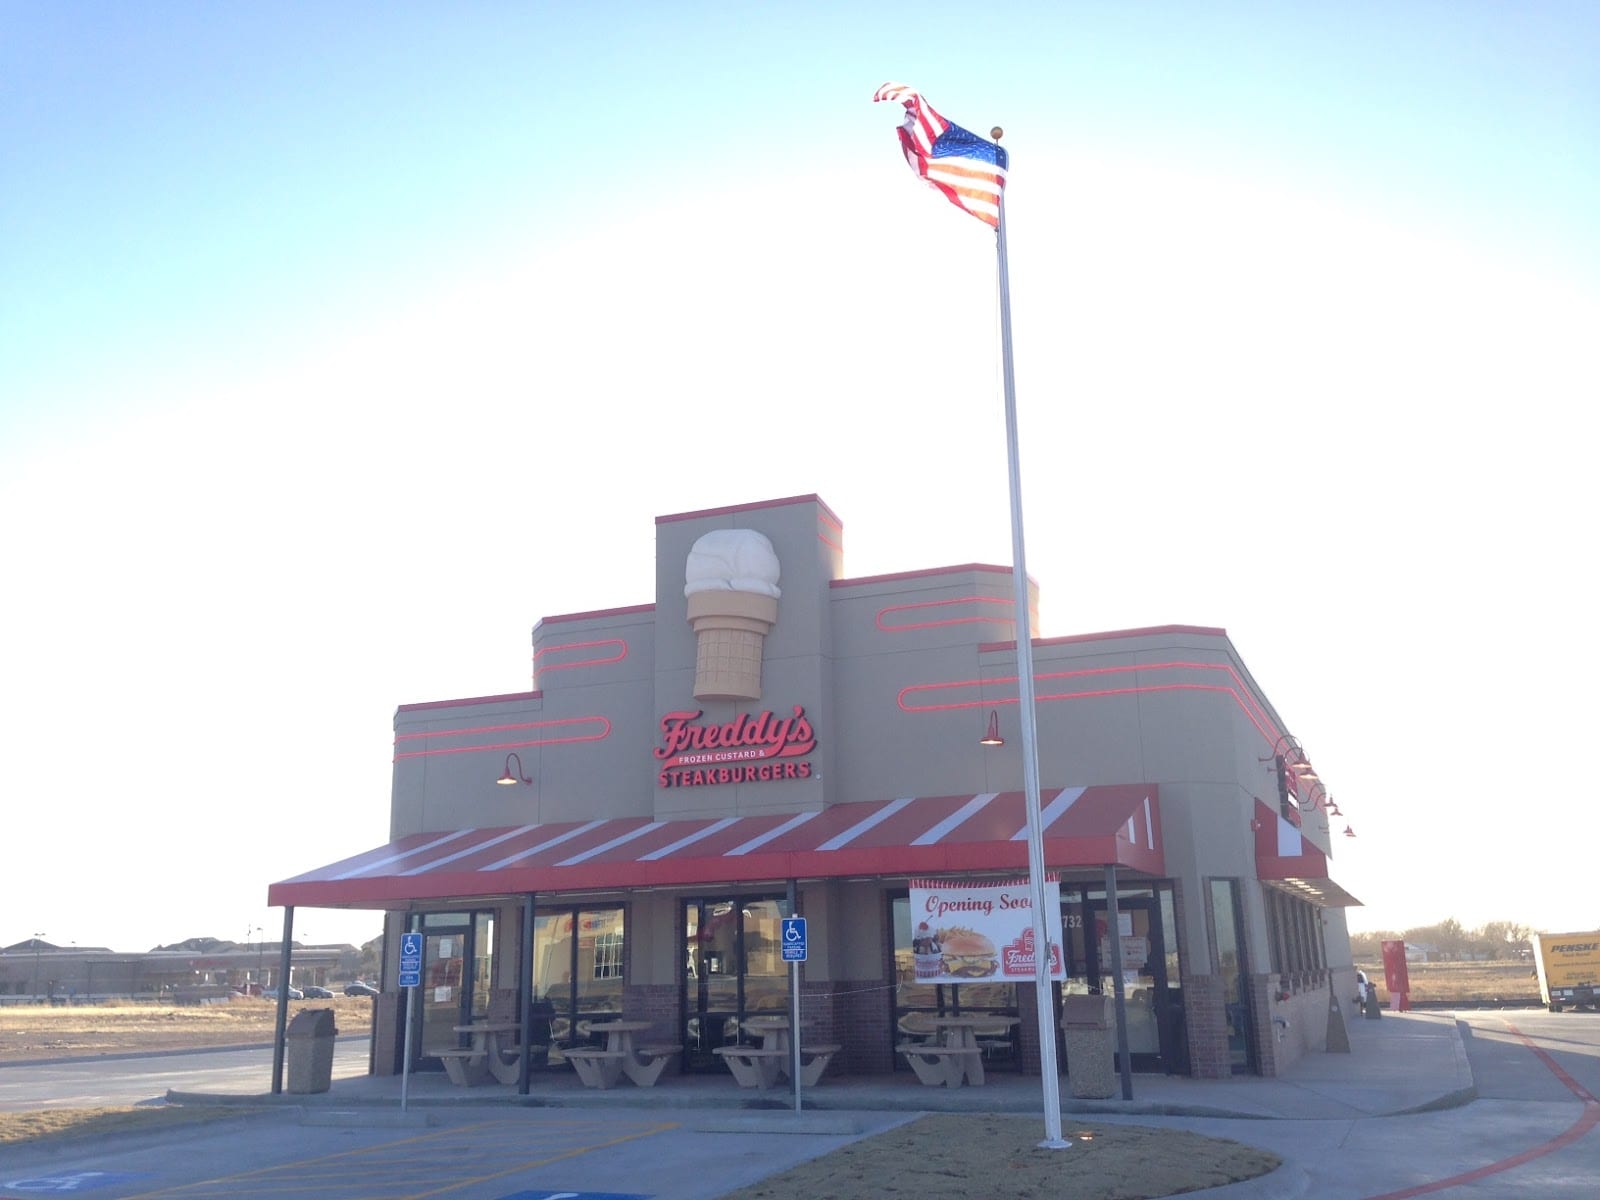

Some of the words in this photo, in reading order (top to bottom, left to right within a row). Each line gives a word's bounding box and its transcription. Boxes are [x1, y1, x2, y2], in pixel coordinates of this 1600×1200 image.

[653, 705, 817, 760] Freddy's
[679, 754, 713, 764] FROZEN
[715, 750, 756, 761] CUSTARD
[758, 749, 765, 757] &
[658, 761, 812, 789] STEAKBURGERS
[925, 895, 995, 917] Opening
